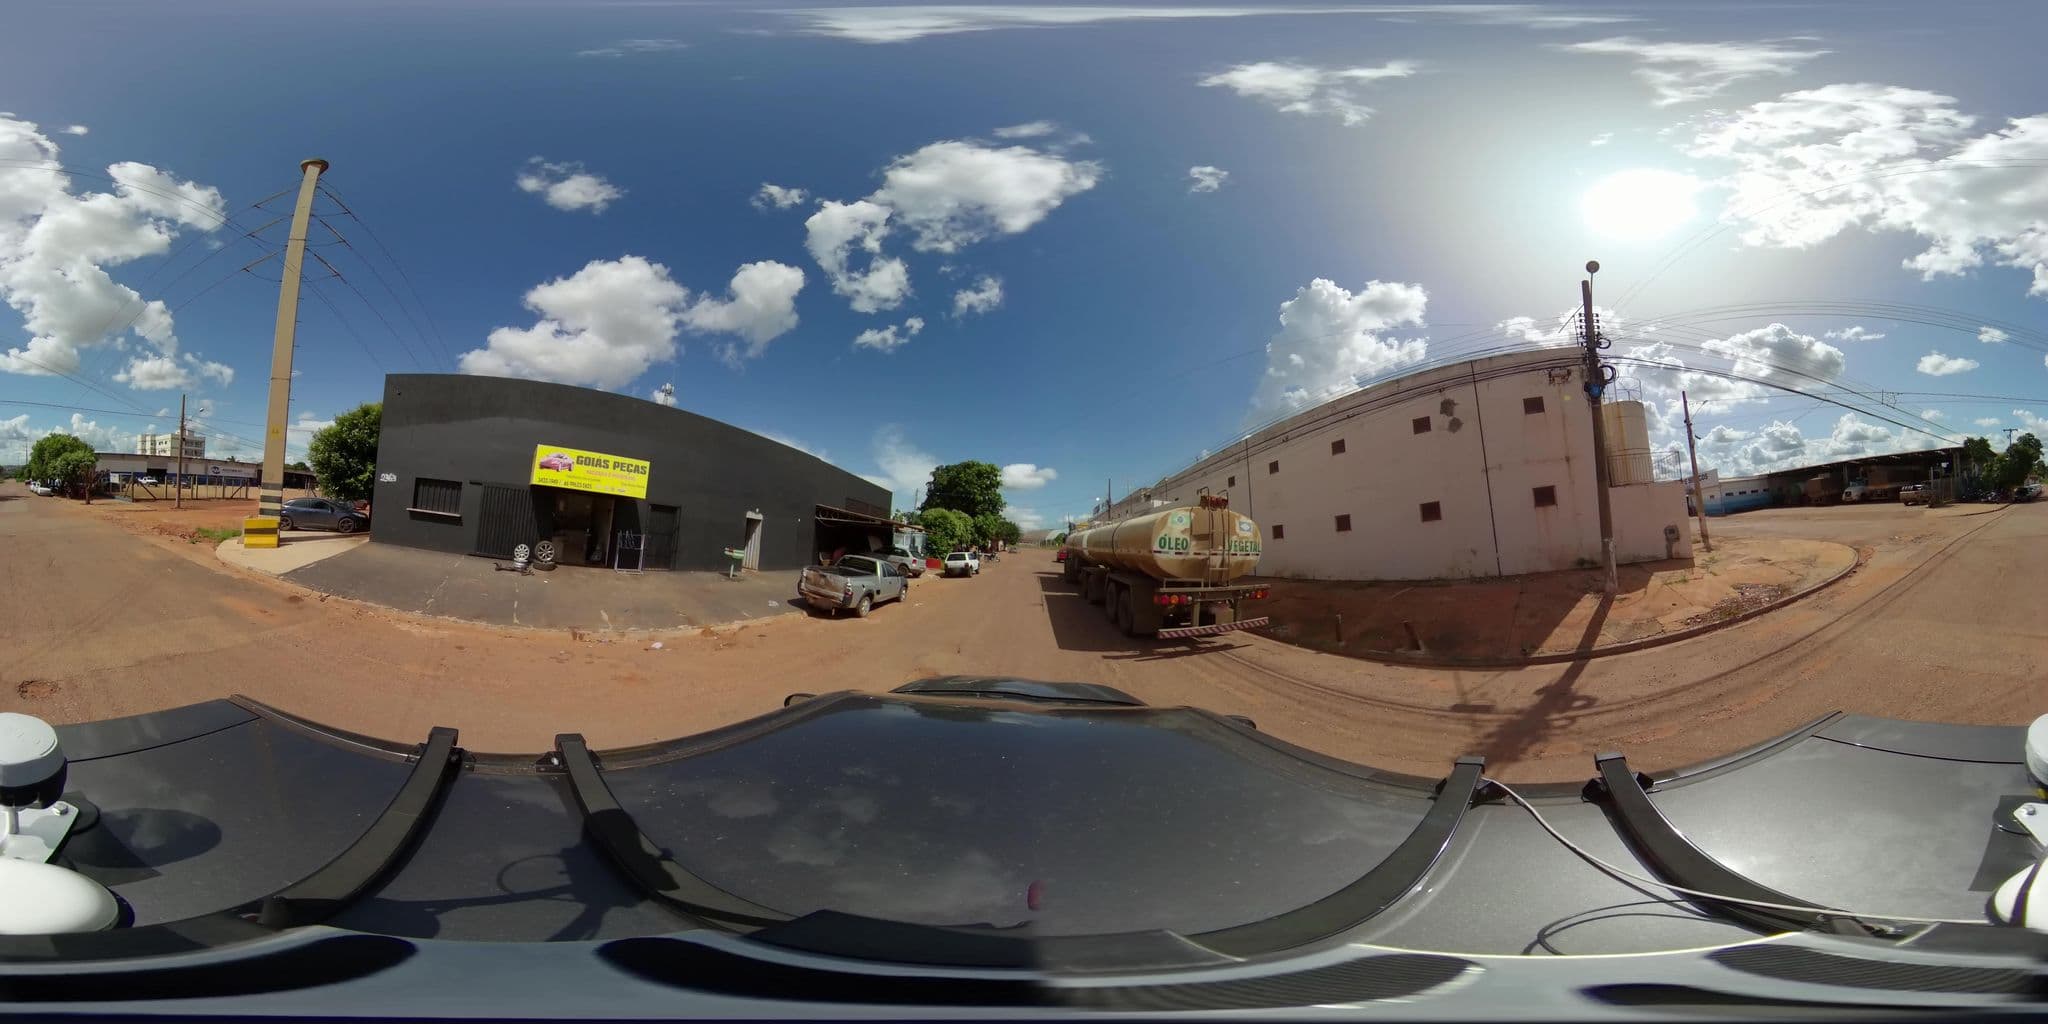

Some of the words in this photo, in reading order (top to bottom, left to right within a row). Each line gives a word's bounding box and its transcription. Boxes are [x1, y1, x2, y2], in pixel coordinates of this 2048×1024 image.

[576, 455, 610, 469] GOIÁS
[613, 461, 648, 475] PEÇAS
[1158, 533, 1189, 551] ÓLEO
[1228, 539, 1261, 553] VEGETAL
